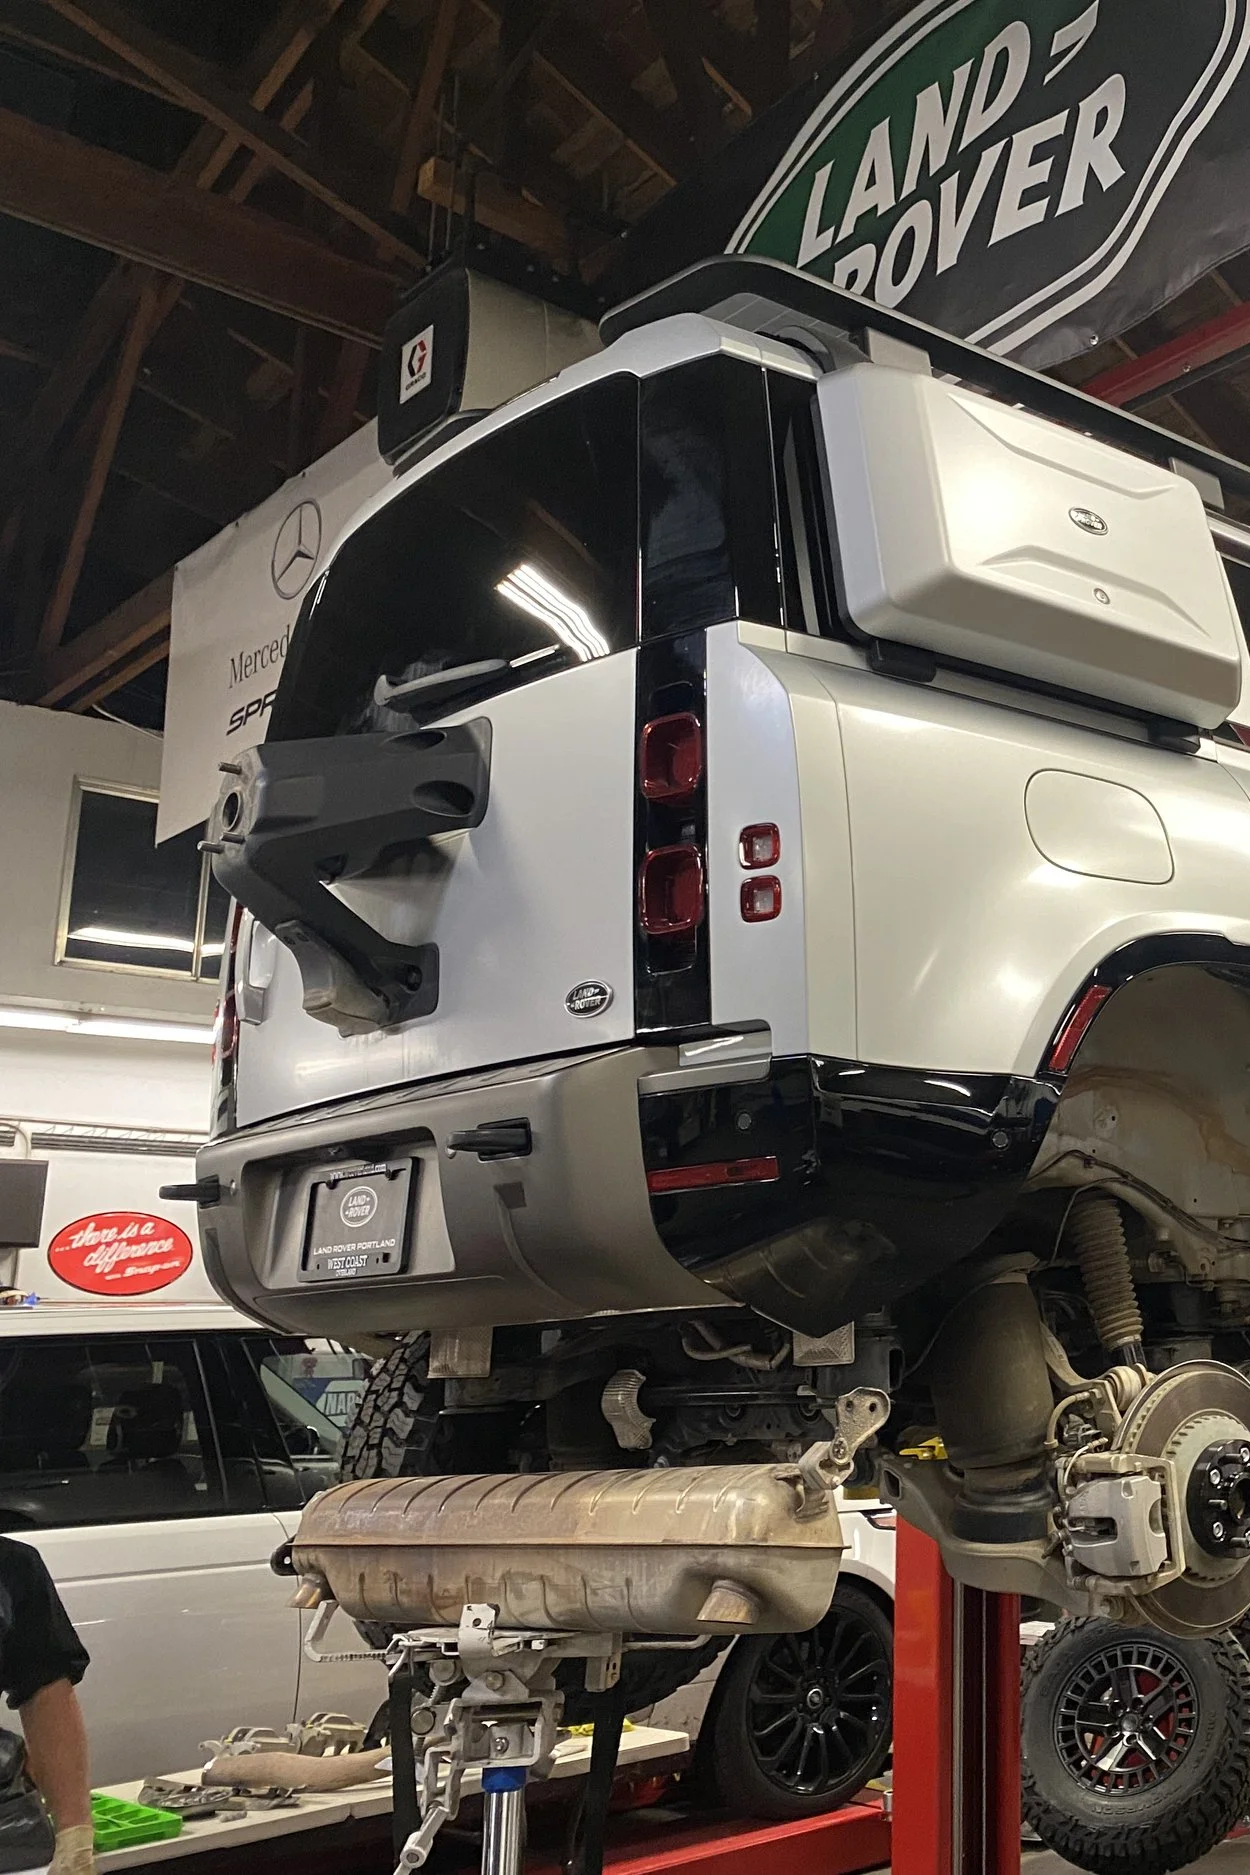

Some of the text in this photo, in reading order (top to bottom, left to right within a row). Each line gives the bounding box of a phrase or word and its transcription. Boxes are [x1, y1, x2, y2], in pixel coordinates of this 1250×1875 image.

[118, 1221, 138, 1240] is
[140, 1221, 155, 1235] a
[83, 1237, 174, 1274] difference
[313, 1238, 396, 1255] LAND ROVER PORTLAND
[327, 1255, 368, 1270] WEST COAST
